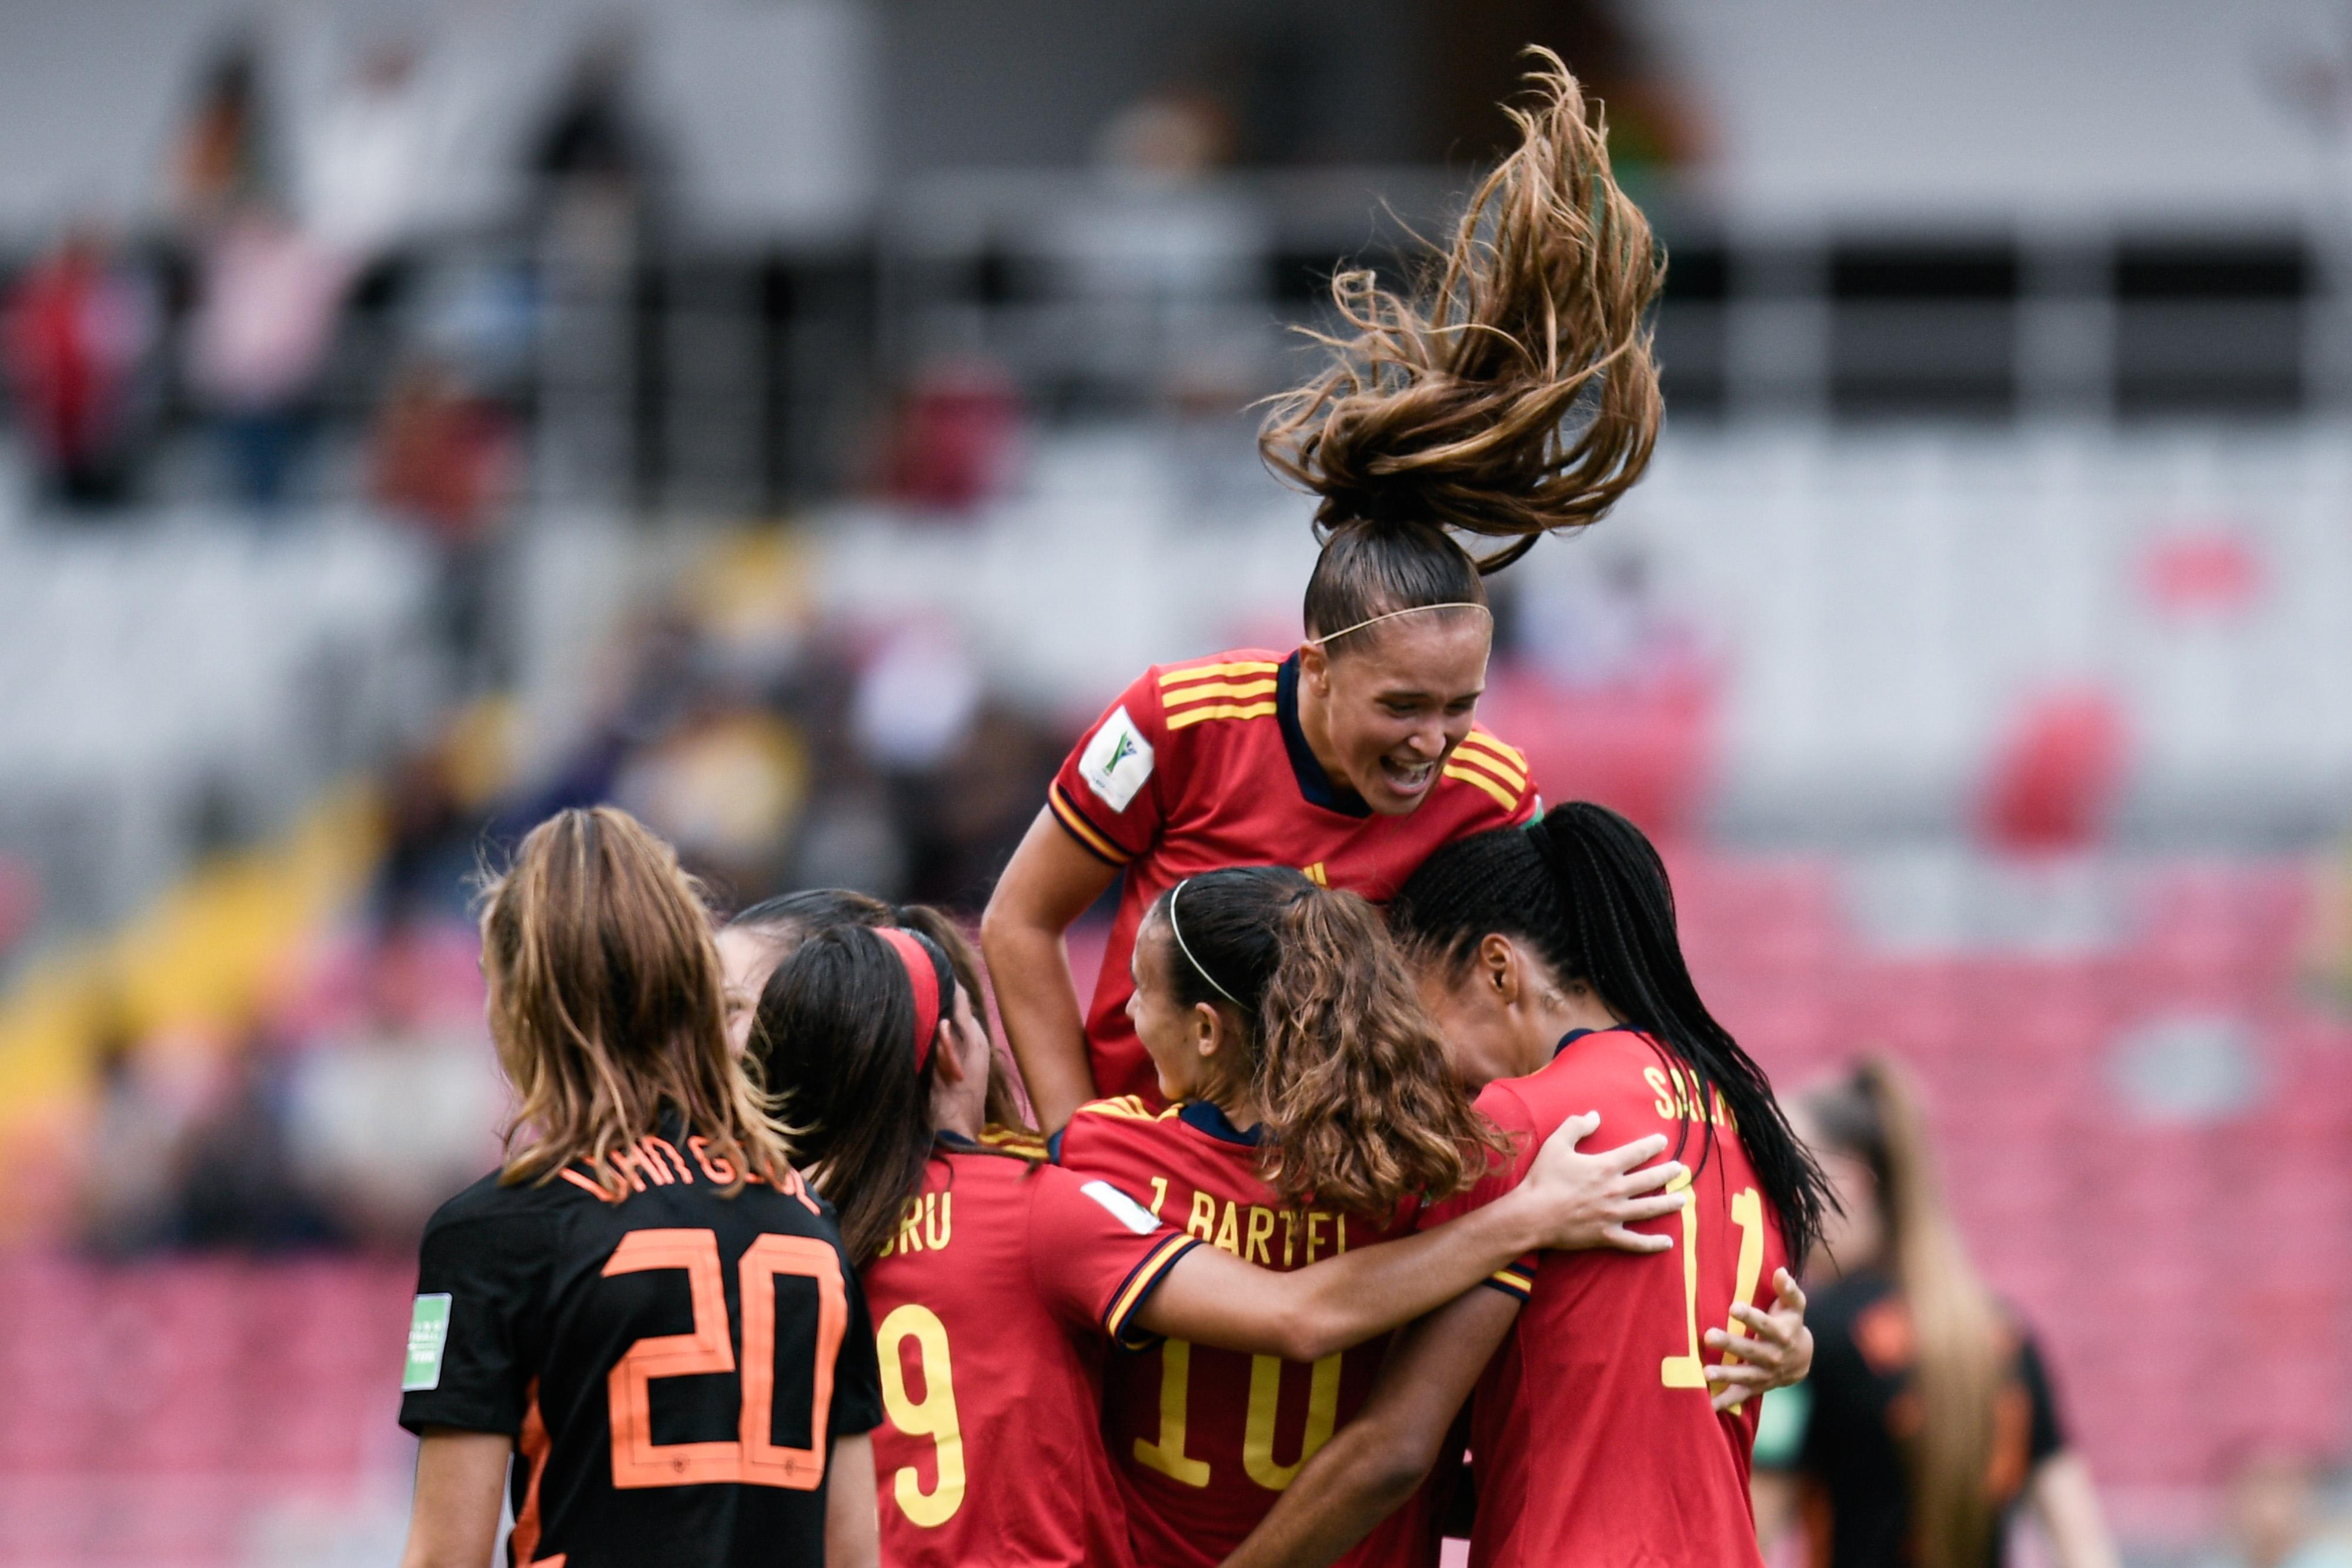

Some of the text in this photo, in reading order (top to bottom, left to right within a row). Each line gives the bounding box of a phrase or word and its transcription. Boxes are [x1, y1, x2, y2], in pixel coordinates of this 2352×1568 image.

[876, 1191, 951, 1257] RU
[1661, 1165, 1763, 1416] 11
[600, 1228, 848, 1491] 20
[876, 1303, 965, 1528] 9
